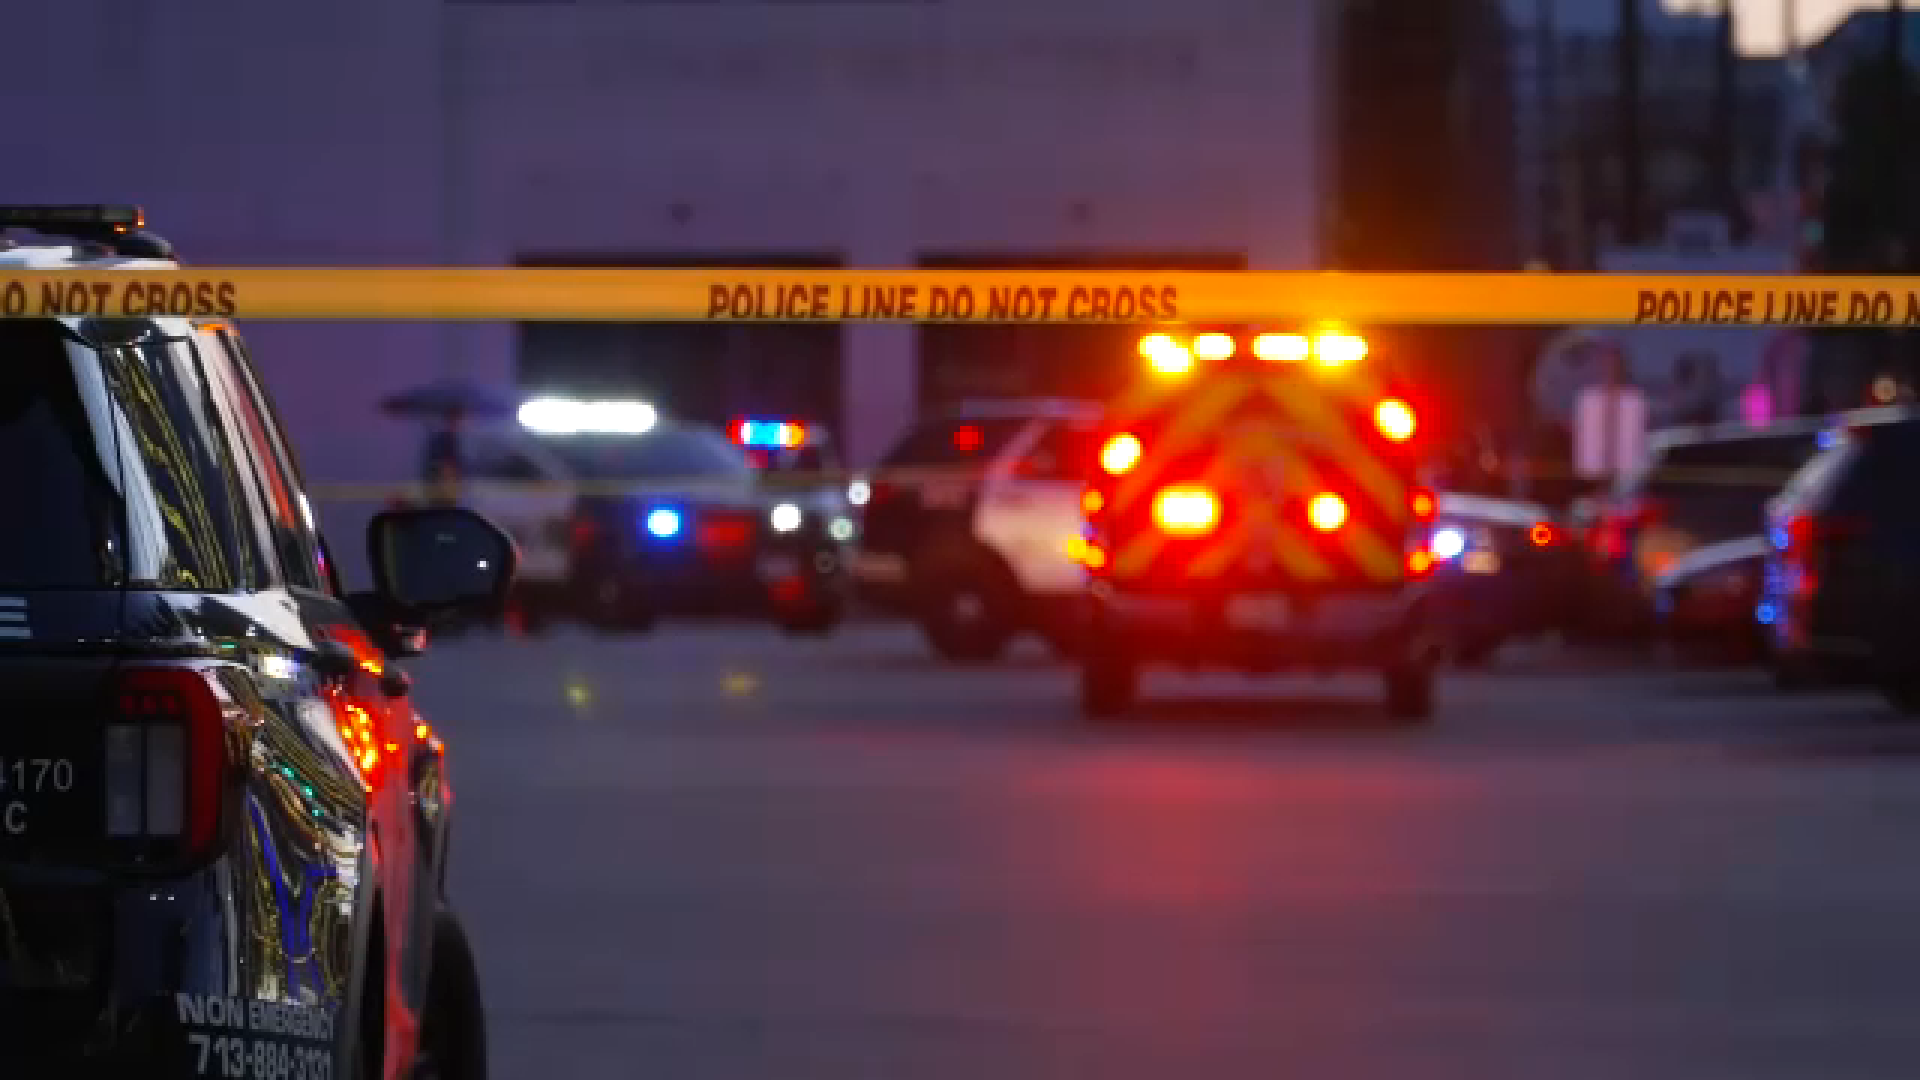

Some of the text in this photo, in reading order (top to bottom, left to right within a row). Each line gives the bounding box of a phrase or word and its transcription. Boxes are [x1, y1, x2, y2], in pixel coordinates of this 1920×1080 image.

[0, 279, 237, 316] O NOT CROSS
[708, 283, 1177, 321] POLICE LINE DO NOT CROSS
[1635, 288, 1755, 323] POLICE
[1762, 290, 1839, 324] LINE
[1847, 290, 1894, 324] DO
[4, 801, 28, 834] C
[176, 992, 244, 1027] NON
